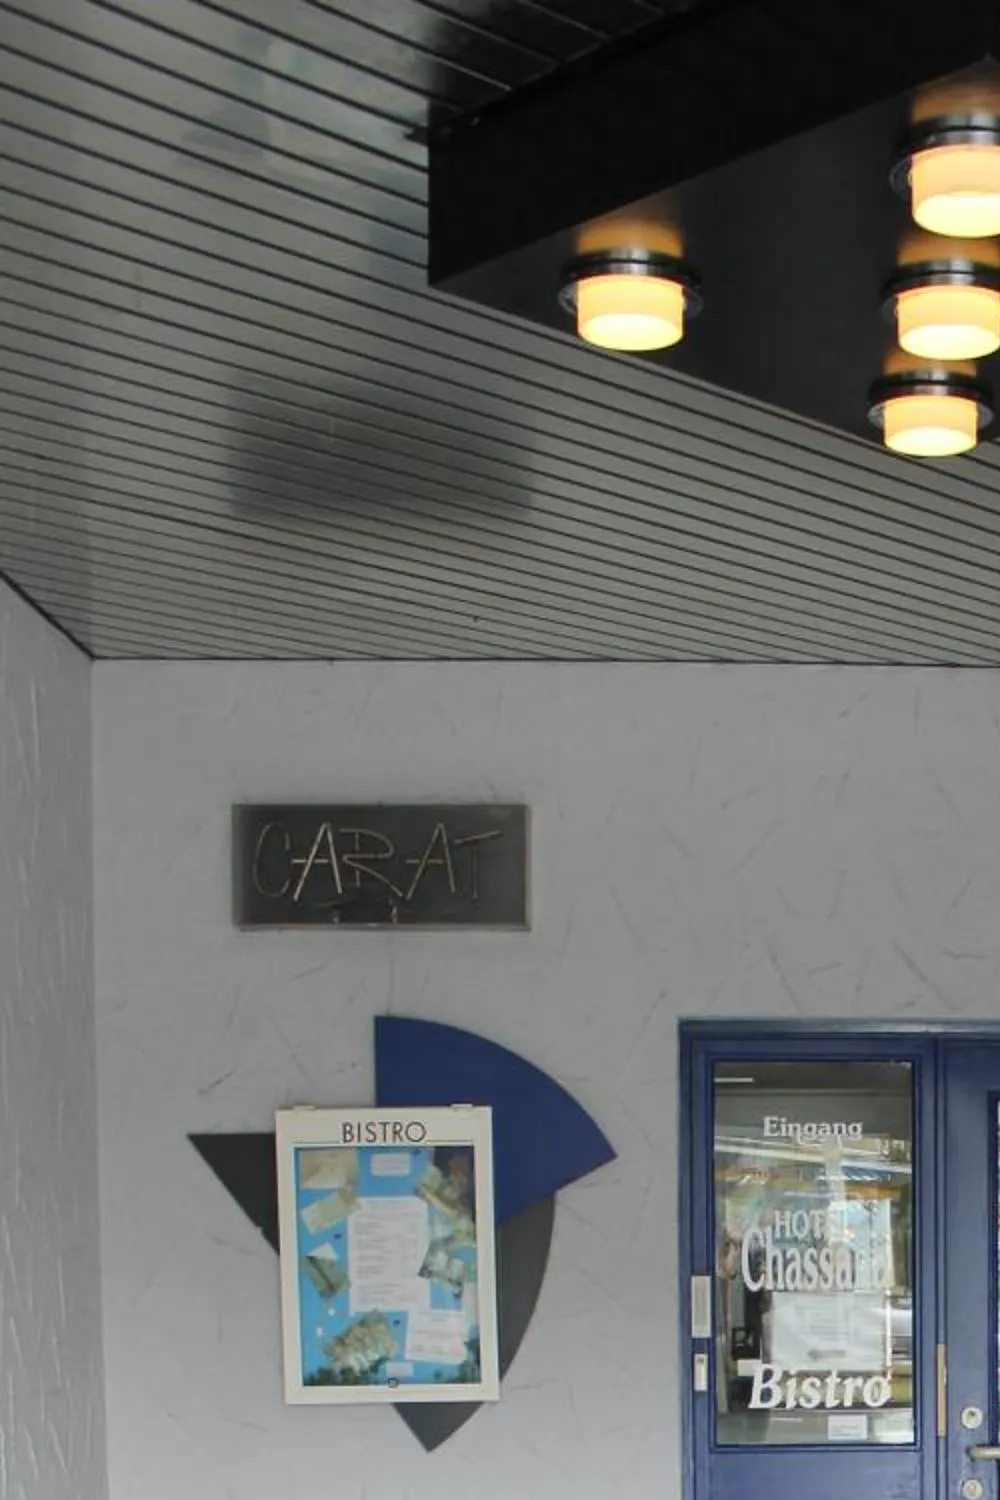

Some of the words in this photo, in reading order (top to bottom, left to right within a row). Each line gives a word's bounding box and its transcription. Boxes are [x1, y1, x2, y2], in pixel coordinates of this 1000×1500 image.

[252, 821, 503, 902] CARAT
[341, 1121, 428, 1144] BISTRO
[762, 1116, 863, 1145] Eingang
[748, 1363, 892, 1410] Bistro
